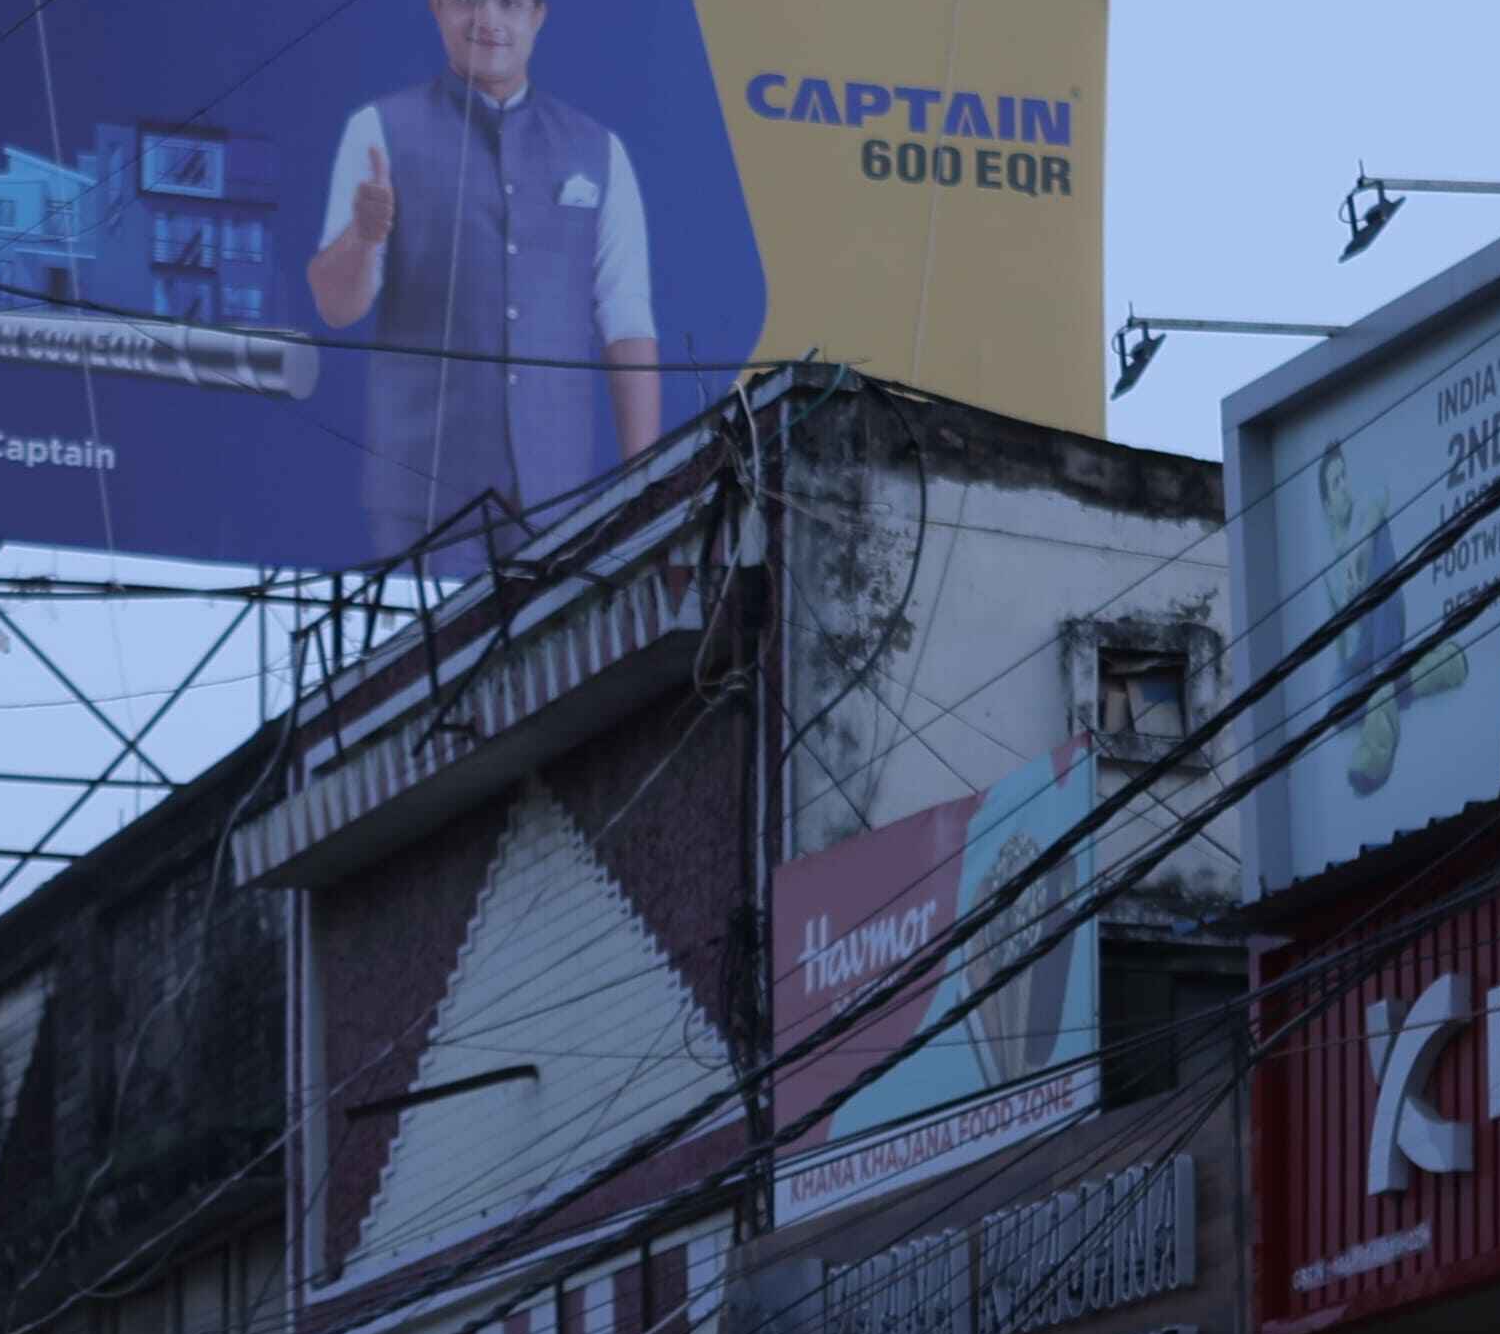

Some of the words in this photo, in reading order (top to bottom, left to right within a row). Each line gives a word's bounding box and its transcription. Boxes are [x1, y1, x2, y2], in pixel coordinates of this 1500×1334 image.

[746, 72, 1072, 146] CAPTAIN
[862, 138, 962, 189] 600
[976, 150, 1073, 198] EQR
[796, 898, 937, 995] Havmor
[790, 1157, 855, 1204] KHANA
[859, 1122, 954, 1182] KHAJANA
[958, 1101, 1014, 1141] FOOD
[1019, 1077, 1073, 1124] ZONE
